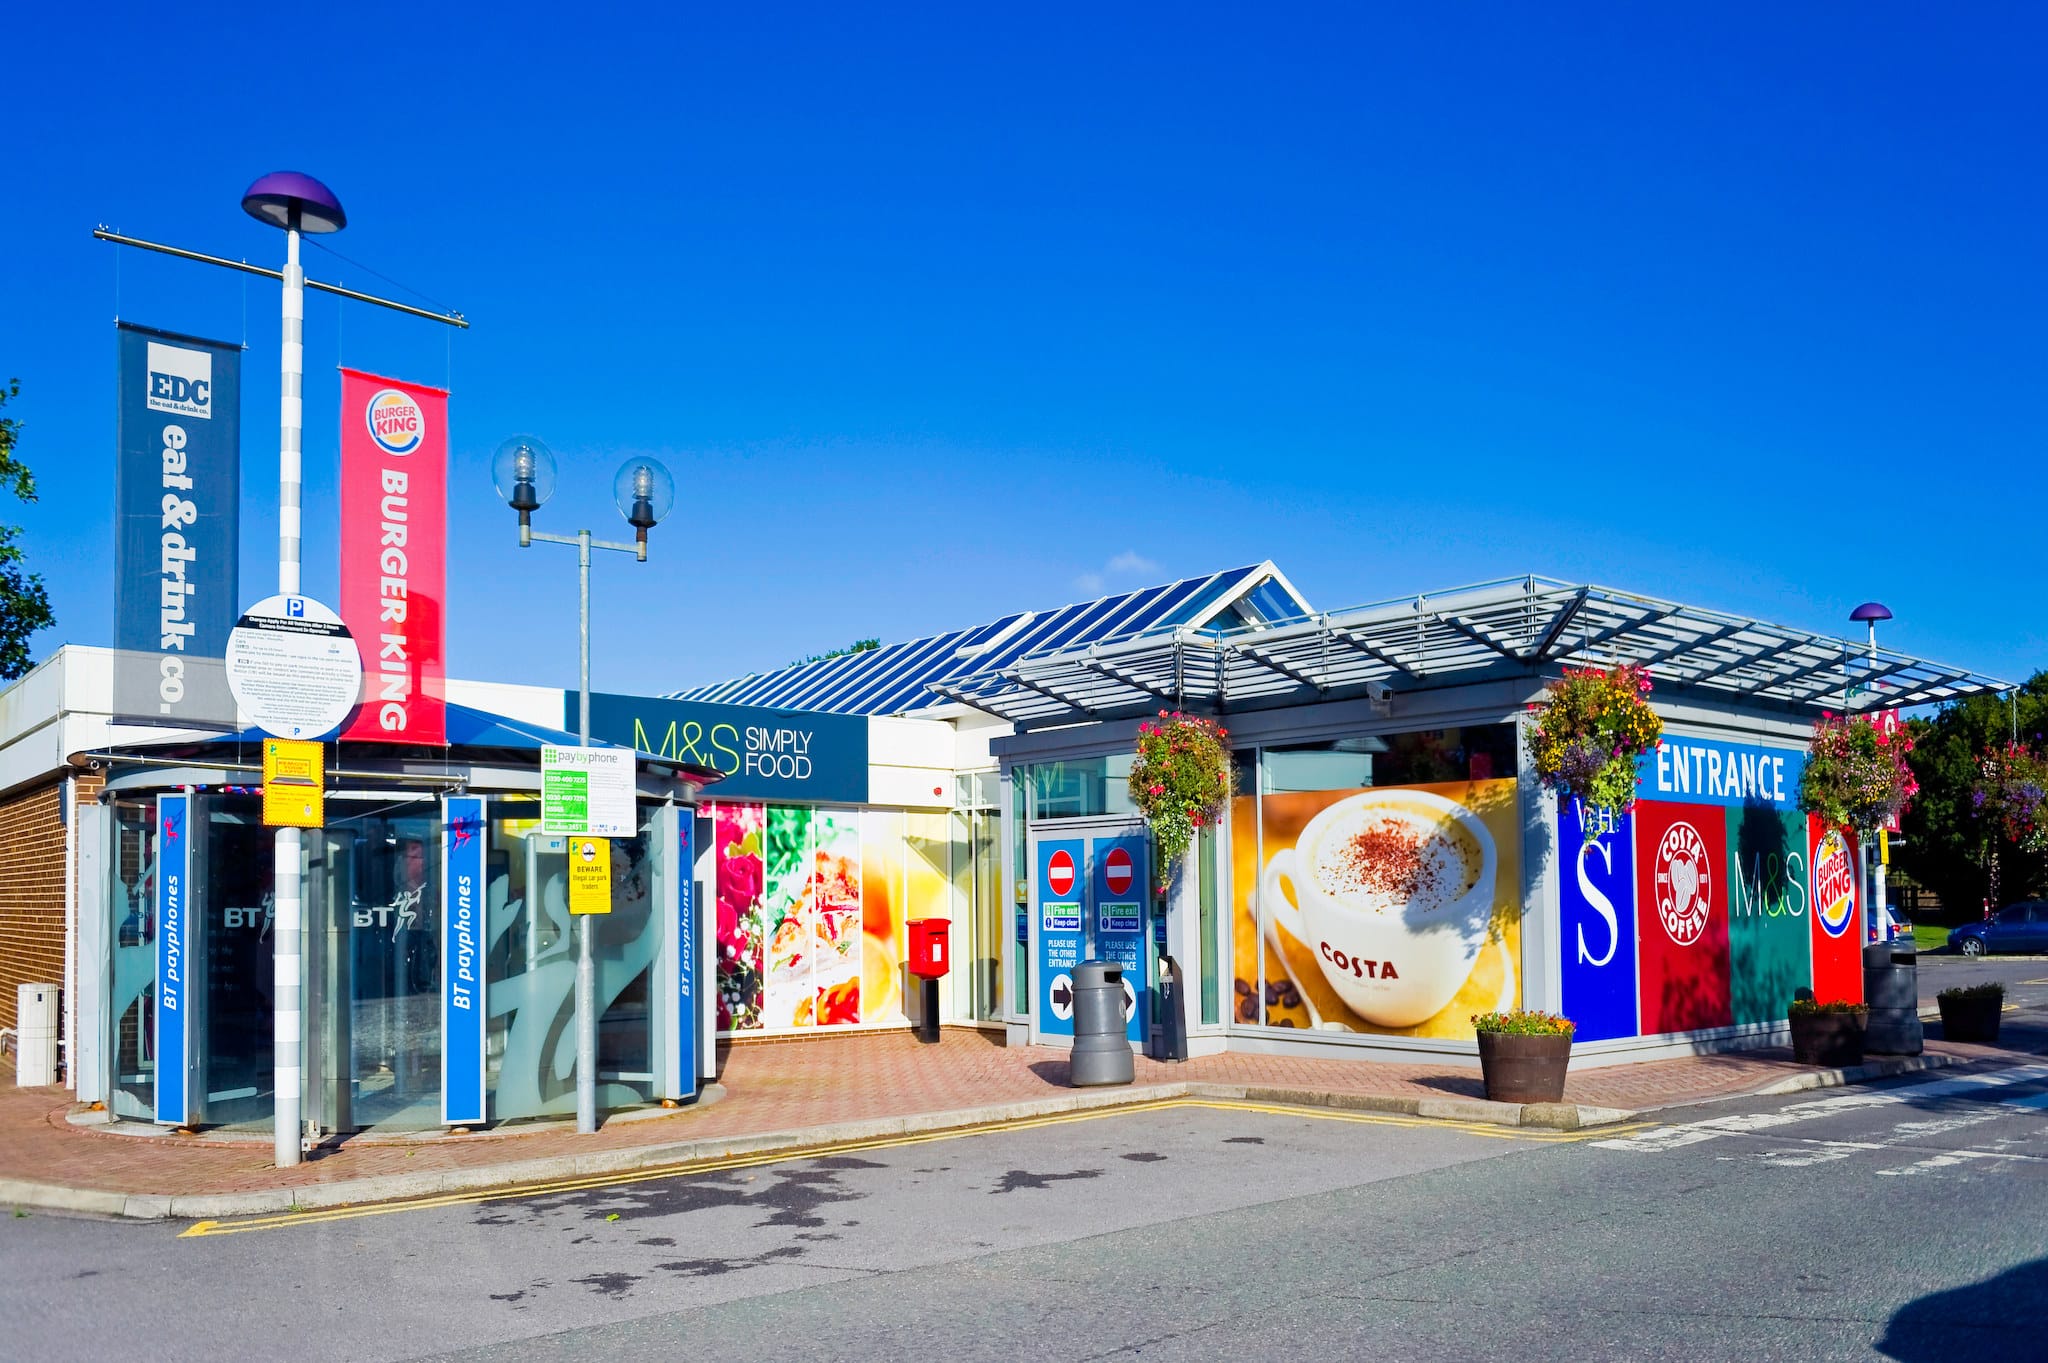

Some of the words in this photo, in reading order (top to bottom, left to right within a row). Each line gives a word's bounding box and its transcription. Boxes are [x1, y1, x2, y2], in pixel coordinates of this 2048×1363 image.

[150, 371, 208, 406] EDC
[180, 404, 198, 412] drink
[375, 406, 415, 420] BURGER
[376, 417, 416, 436] KING
[162, 424, 192, 490] eat
[162, 493, 197, 530] &
[380, 468, 408, 624] BURGER
[160, 532, 196, 650] drink
[160, 655, 184, 713] co.
[380, 633, 407, 731] KING
[558, 752, 618, 764] paybyphone
[635, 718, 740, 776] M&S
[746, 726, 812, 754] SIMPLY
[746, 753, 812, 779] FOOD
[1658, 744, 1786, 801] ENTRANCE
[1662, 827, 1700, 864] COSTA
[1735, 851, 1805, 917] M&S
[1818, 851, 1848, 888] BURGER
[1577, 840, 1618, 966] S
[1820, 868, 1850, 914] KING
[224, 908, 262, 928] BT
[353, 906, 394, 927] BT
[682, 880, 690, 972] payphones
[1054, 905, 1065, 914] Fire
[1067, 905, 1078, 914] exit
[1054, 919, 1066, 927] Keep
[1111, 906, 1124, 915] Fire
[1126, 907, 1137, 915] exit
[1111, 920, 1124, 928] Keep
[1662, 896, 1707, 940] COFFEE
[164, 875, 180, 982] payphones
[454, 876, 474, 982] payphones
[1048, 940, 1066, 948] PLEASE
[1067, 940, 1076, 948] USE
[1105, 941, 1124, 949] PLEASE
[1048, 949, 1058, 957] THE
[1059, 950, 1076, 958] OTHER
[1106, 951, 1116, 960] THE
[1117, 951, 1136, 960] OTHER
[1321, 942, 1399, 980] COSTA
[164, 982, 177, 1010] BT
[453, 983, 470, 1010] BT
[682, 973, 689, 996] BT
